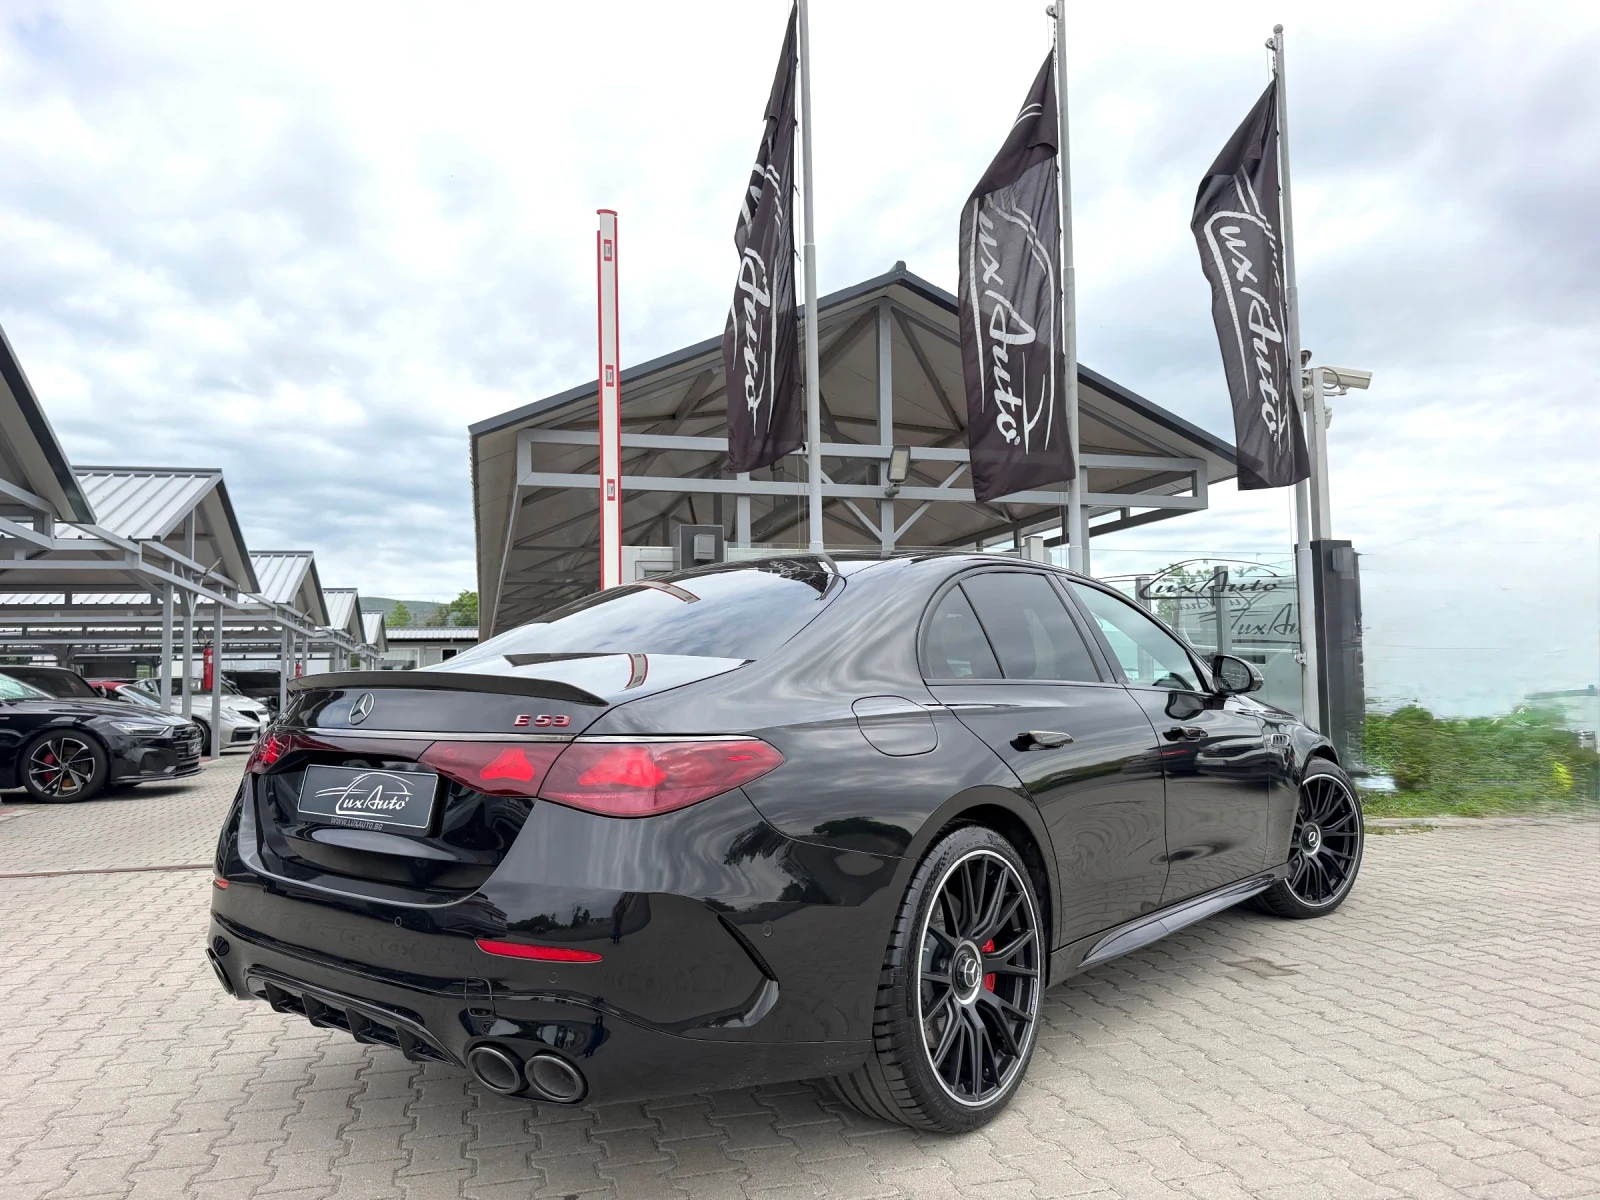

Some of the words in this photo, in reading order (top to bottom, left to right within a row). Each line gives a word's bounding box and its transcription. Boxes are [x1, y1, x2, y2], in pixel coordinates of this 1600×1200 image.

[513, 714, 532, 727] E
[534, 714, 571, 728] 53
[330, 816, 384, 831] WWW.LUXAUTO.BG
